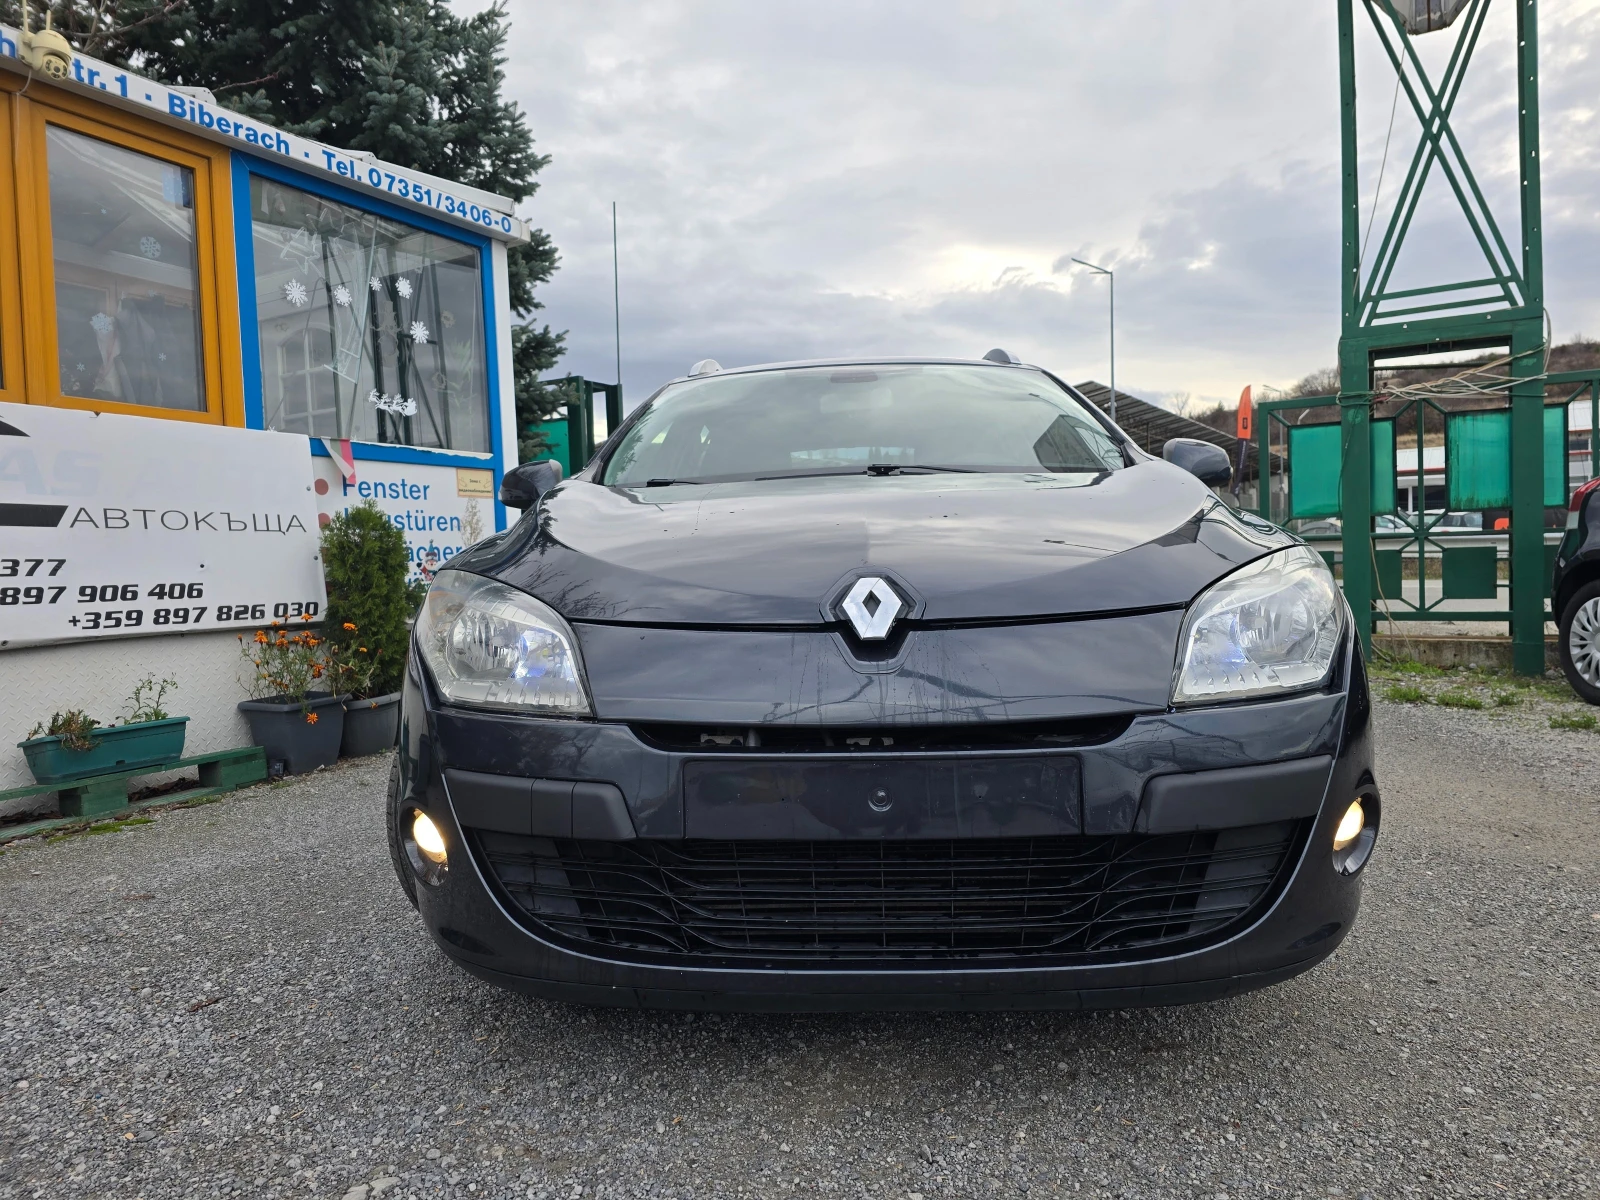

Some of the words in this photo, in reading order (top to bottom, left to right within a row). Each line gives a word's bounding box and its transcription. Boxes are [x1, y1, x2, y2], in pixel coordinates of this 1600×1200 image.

[69, 57, 107, 90] tr.
[168, 92, 290, 155] Biberach
[322, 150, 362, 181] Tel.
[368, 167, 512, 233] 07351/3406-0
[342, 474, 430, 500] Fenster
[69, 507, 307, 535] АВТОКЪЩА
[0, 559, 67, 577] 377
[0, 586, 67, 606] 897
[77, 584, 139, 603] 906
[147, 582, 204, 600] 406
[68, 609, 144, 630] +359
[152, 606, 208, 624] 897
[216, 604, 266, 621] 826
[273, 602, 319, 617] 030
